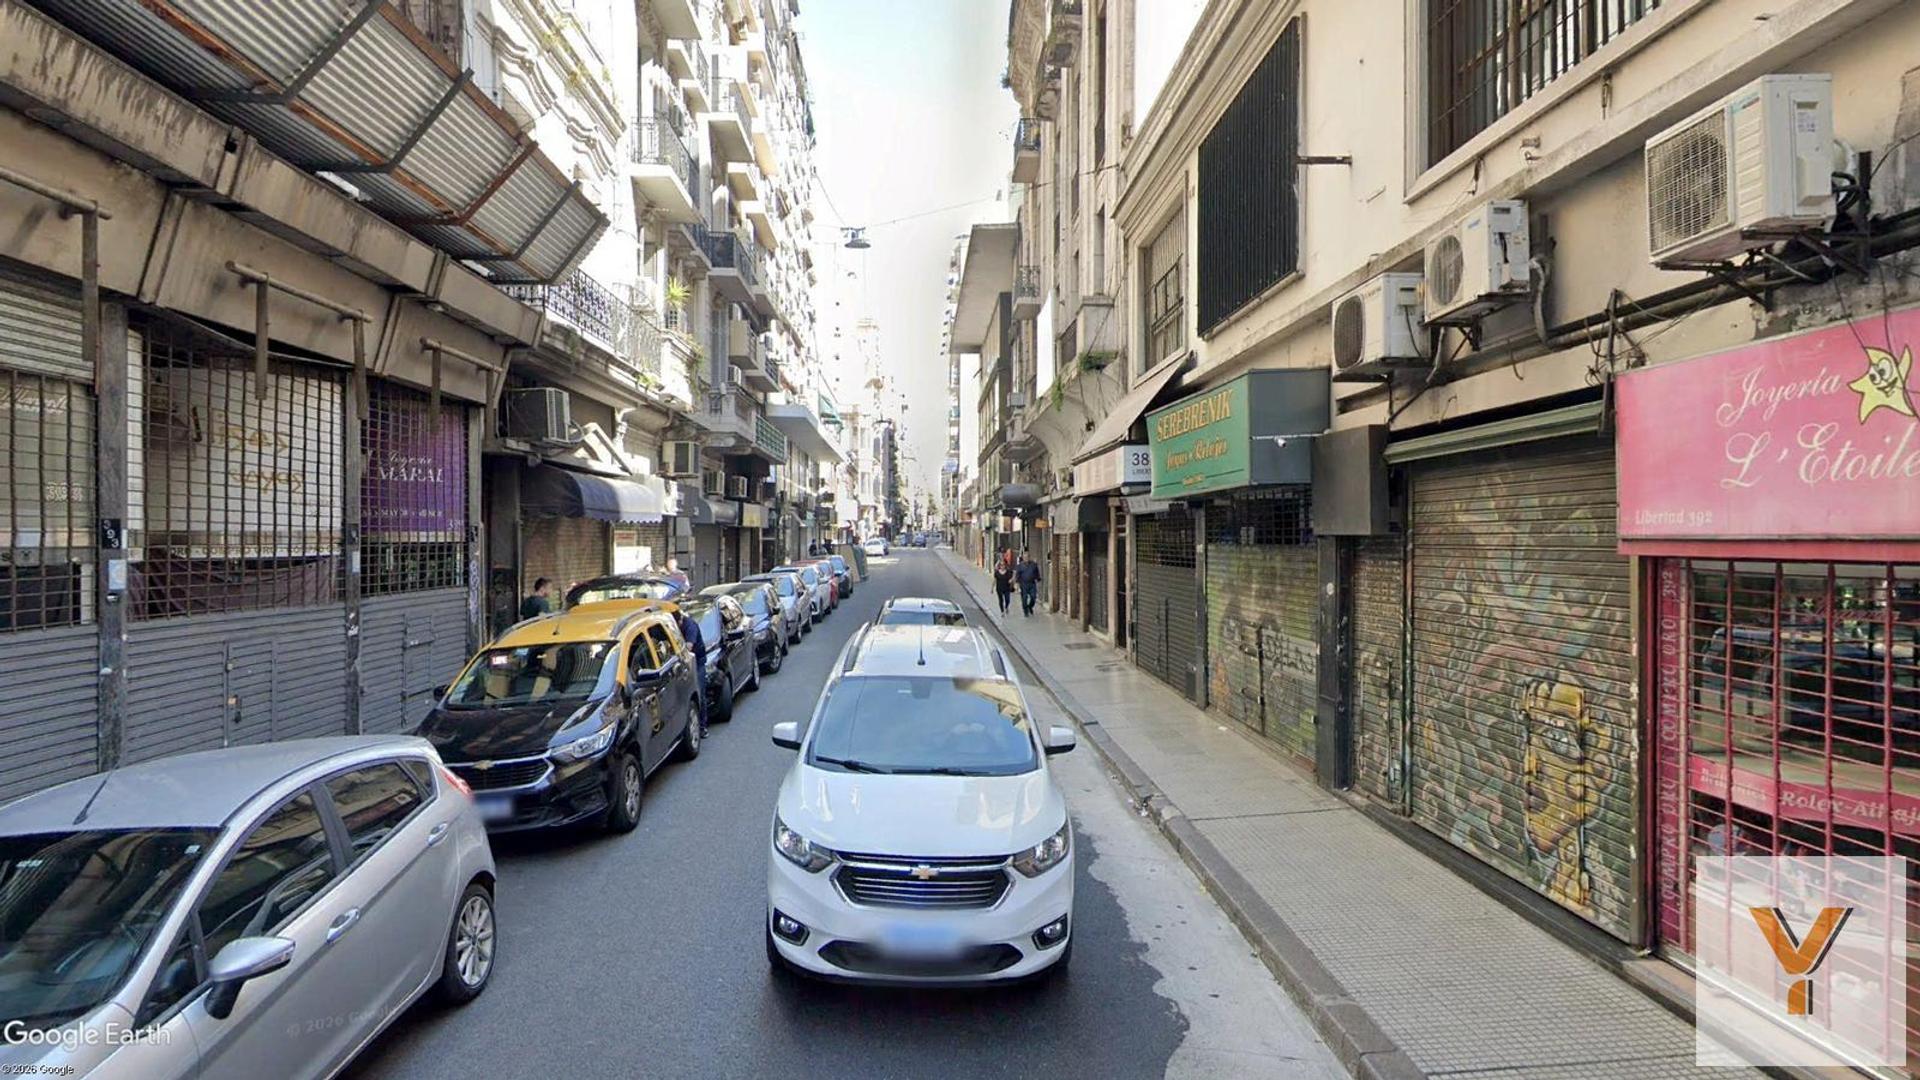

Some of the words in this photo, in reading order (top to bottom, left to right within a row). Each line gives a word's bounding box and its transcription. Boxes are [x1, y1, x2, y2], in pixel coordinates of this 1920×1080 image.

[1157, 388, 1233, 442] SEREBRENIK
[1717, 366, 1842, 428] Joyería
[1635, 510, 1685, 526] Libertad
[1687, 511, 1714, 527] 392
